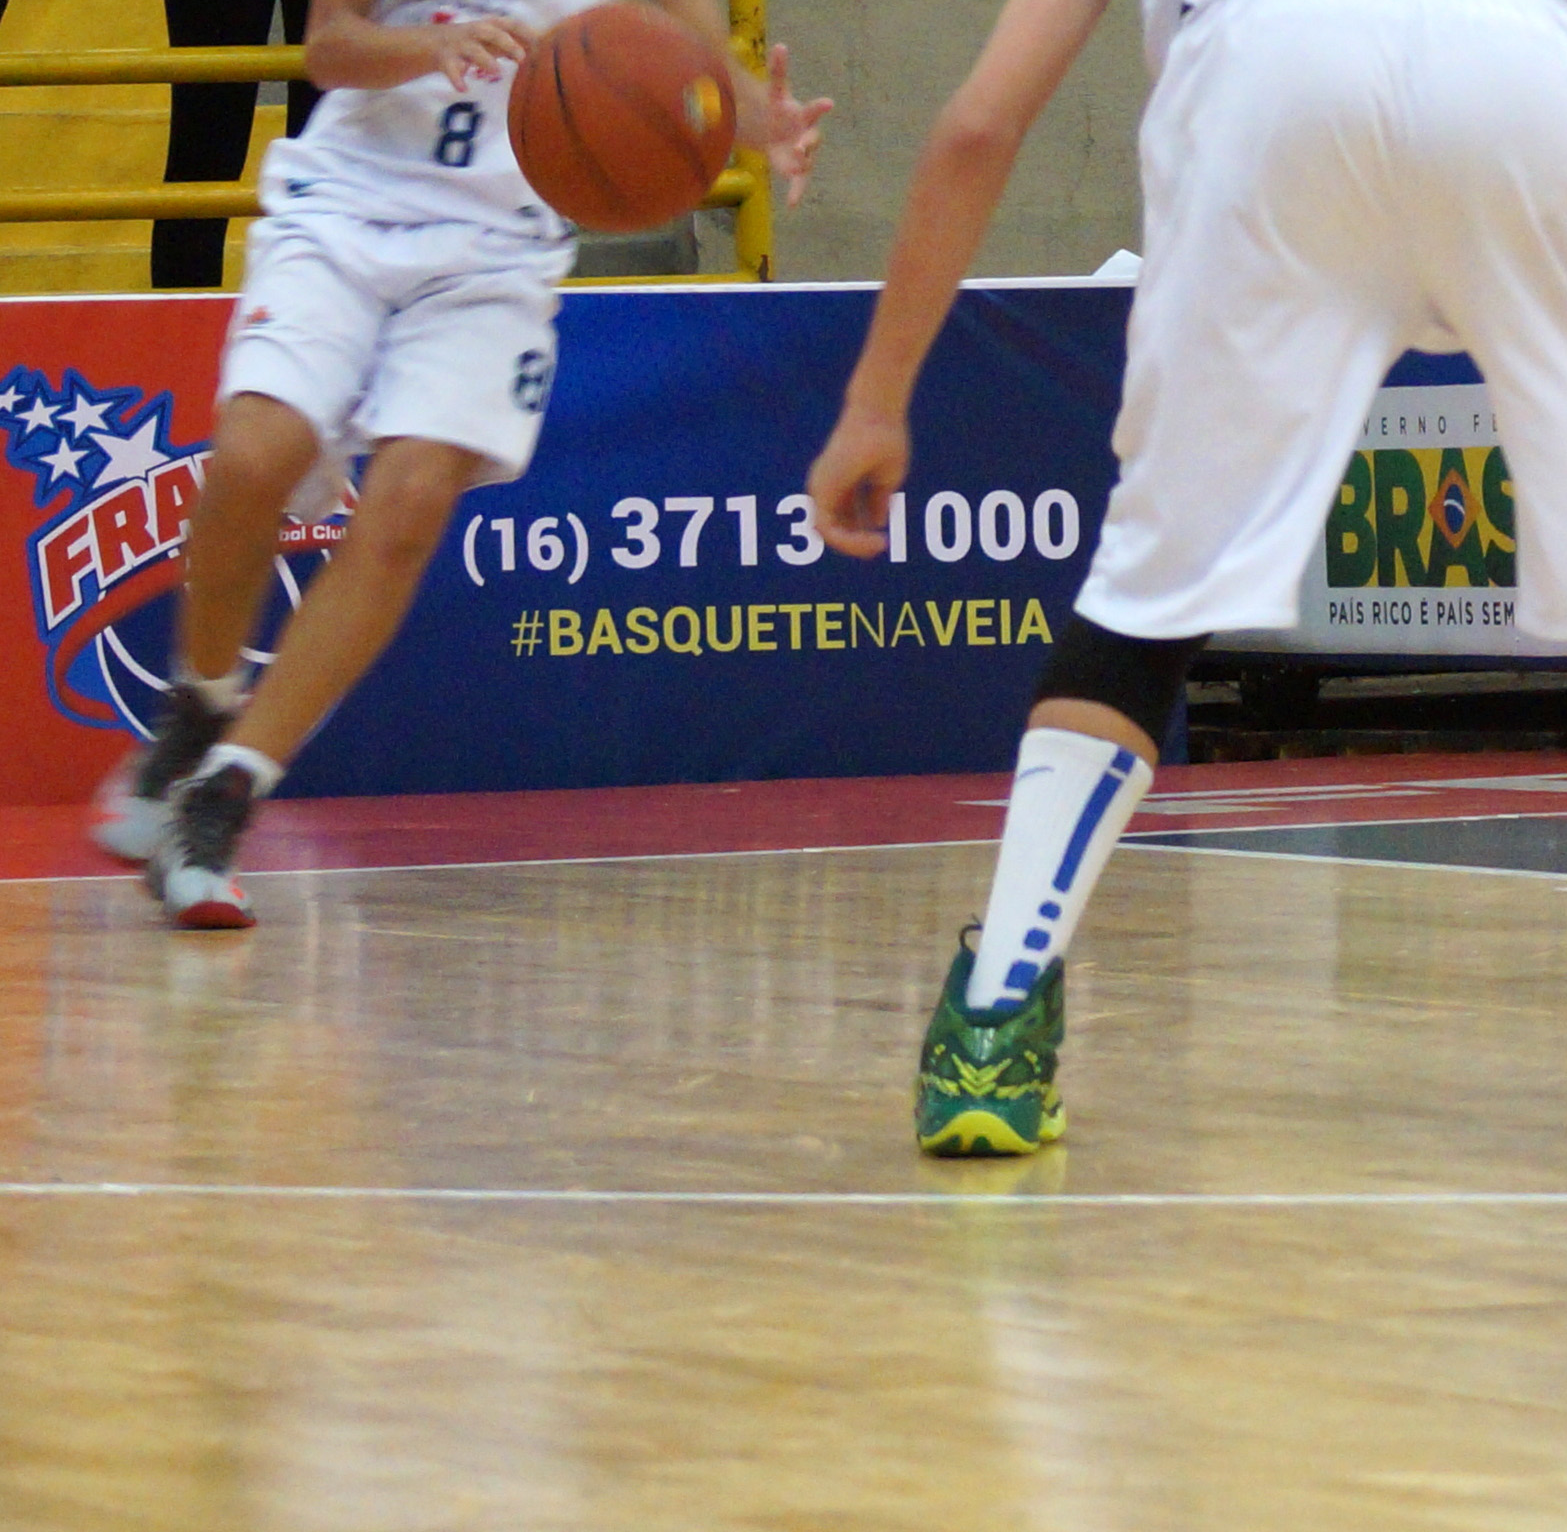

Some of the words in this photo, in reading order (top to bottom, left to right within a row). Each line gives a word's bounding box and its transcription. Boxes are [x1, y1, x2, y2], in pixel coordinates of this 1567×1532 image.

[434, 100, 483, 168] 8
[463, 512, 589, 586] (16)
[1325, 445, 1517, 589] BRAS
[510, 597, 1053, 658] #BASQUETENAVEIA
[1328, 597, 1364, 627] PAÍS
[1372, 601, 1412, 626] RICO
[1420, 597, 1429, 625] É
[1436, 597, 1474, 626] PAÍS
[1482, 601, 1515, 626] SEM
